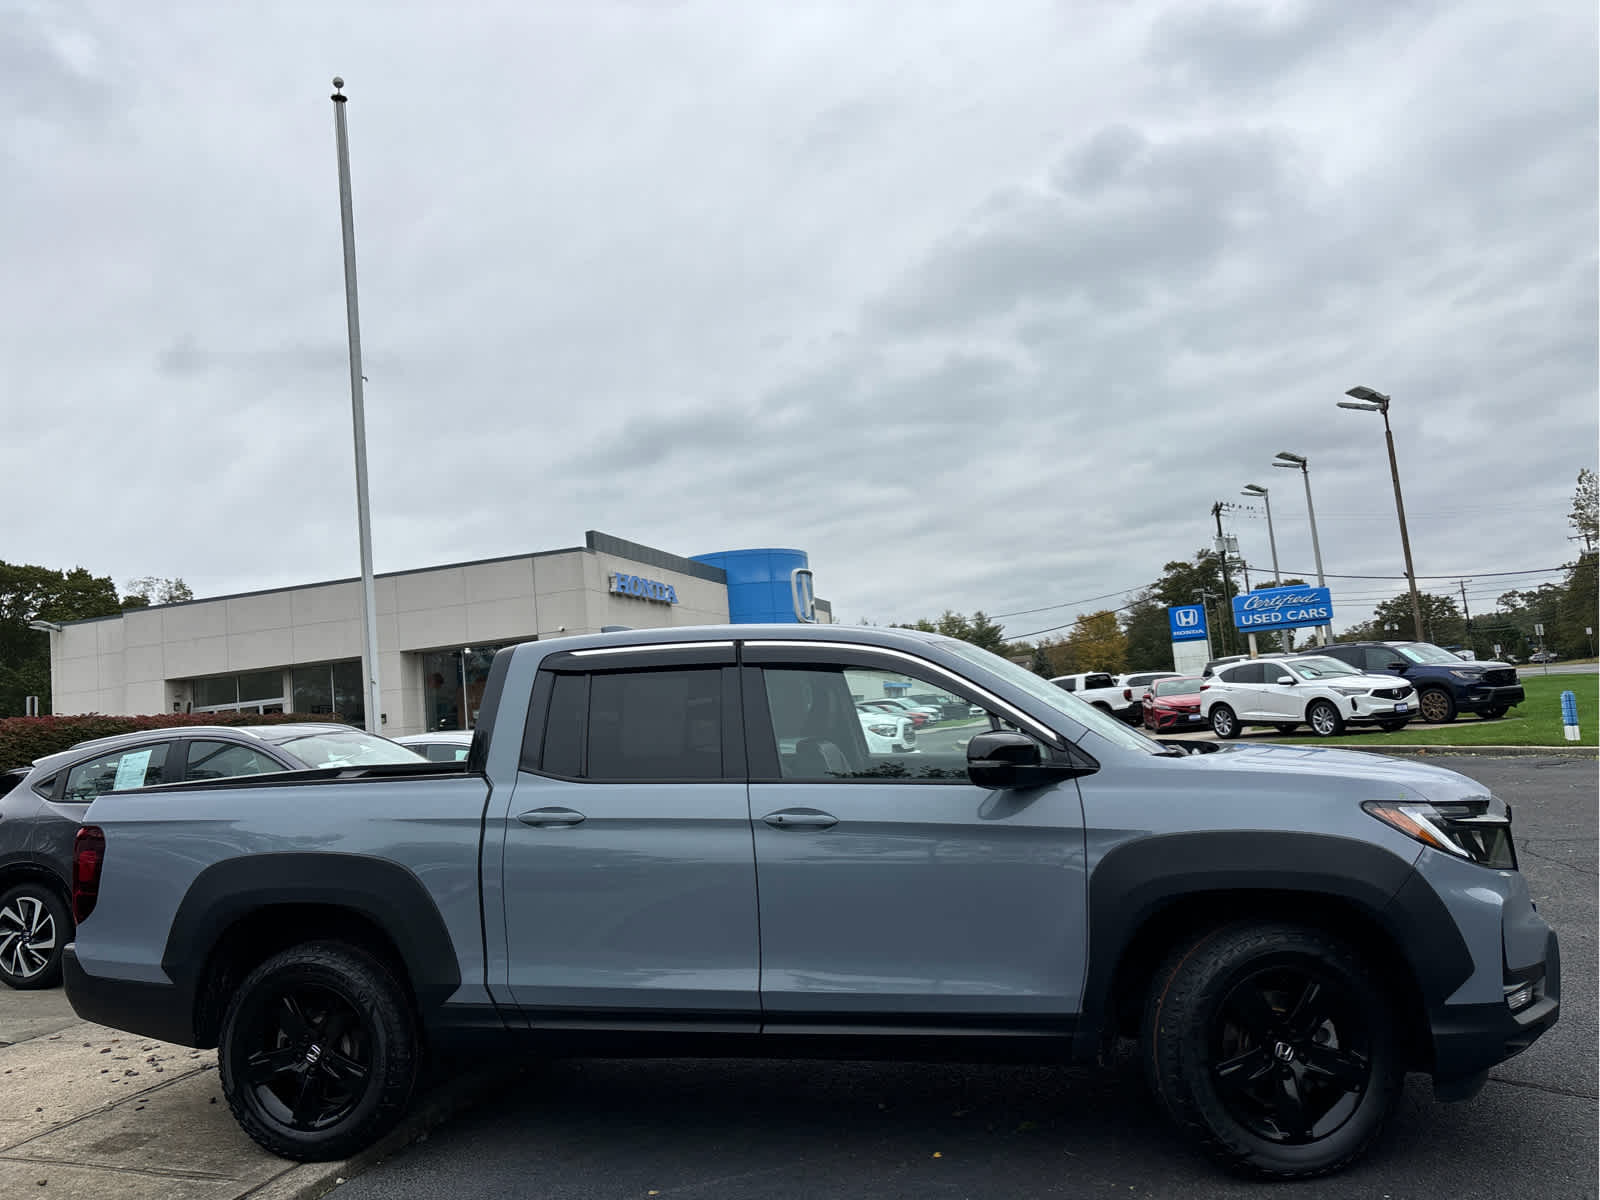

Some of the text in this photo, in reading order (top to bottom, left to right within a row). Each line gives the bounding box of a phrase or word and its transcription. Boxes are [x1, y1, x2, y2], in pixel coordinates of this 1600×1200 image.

[615, 572, 679, 604] HONDA
[1244, 592, 1320, 611] Certified
[1242, 608, 1328, 625] USED CARS
